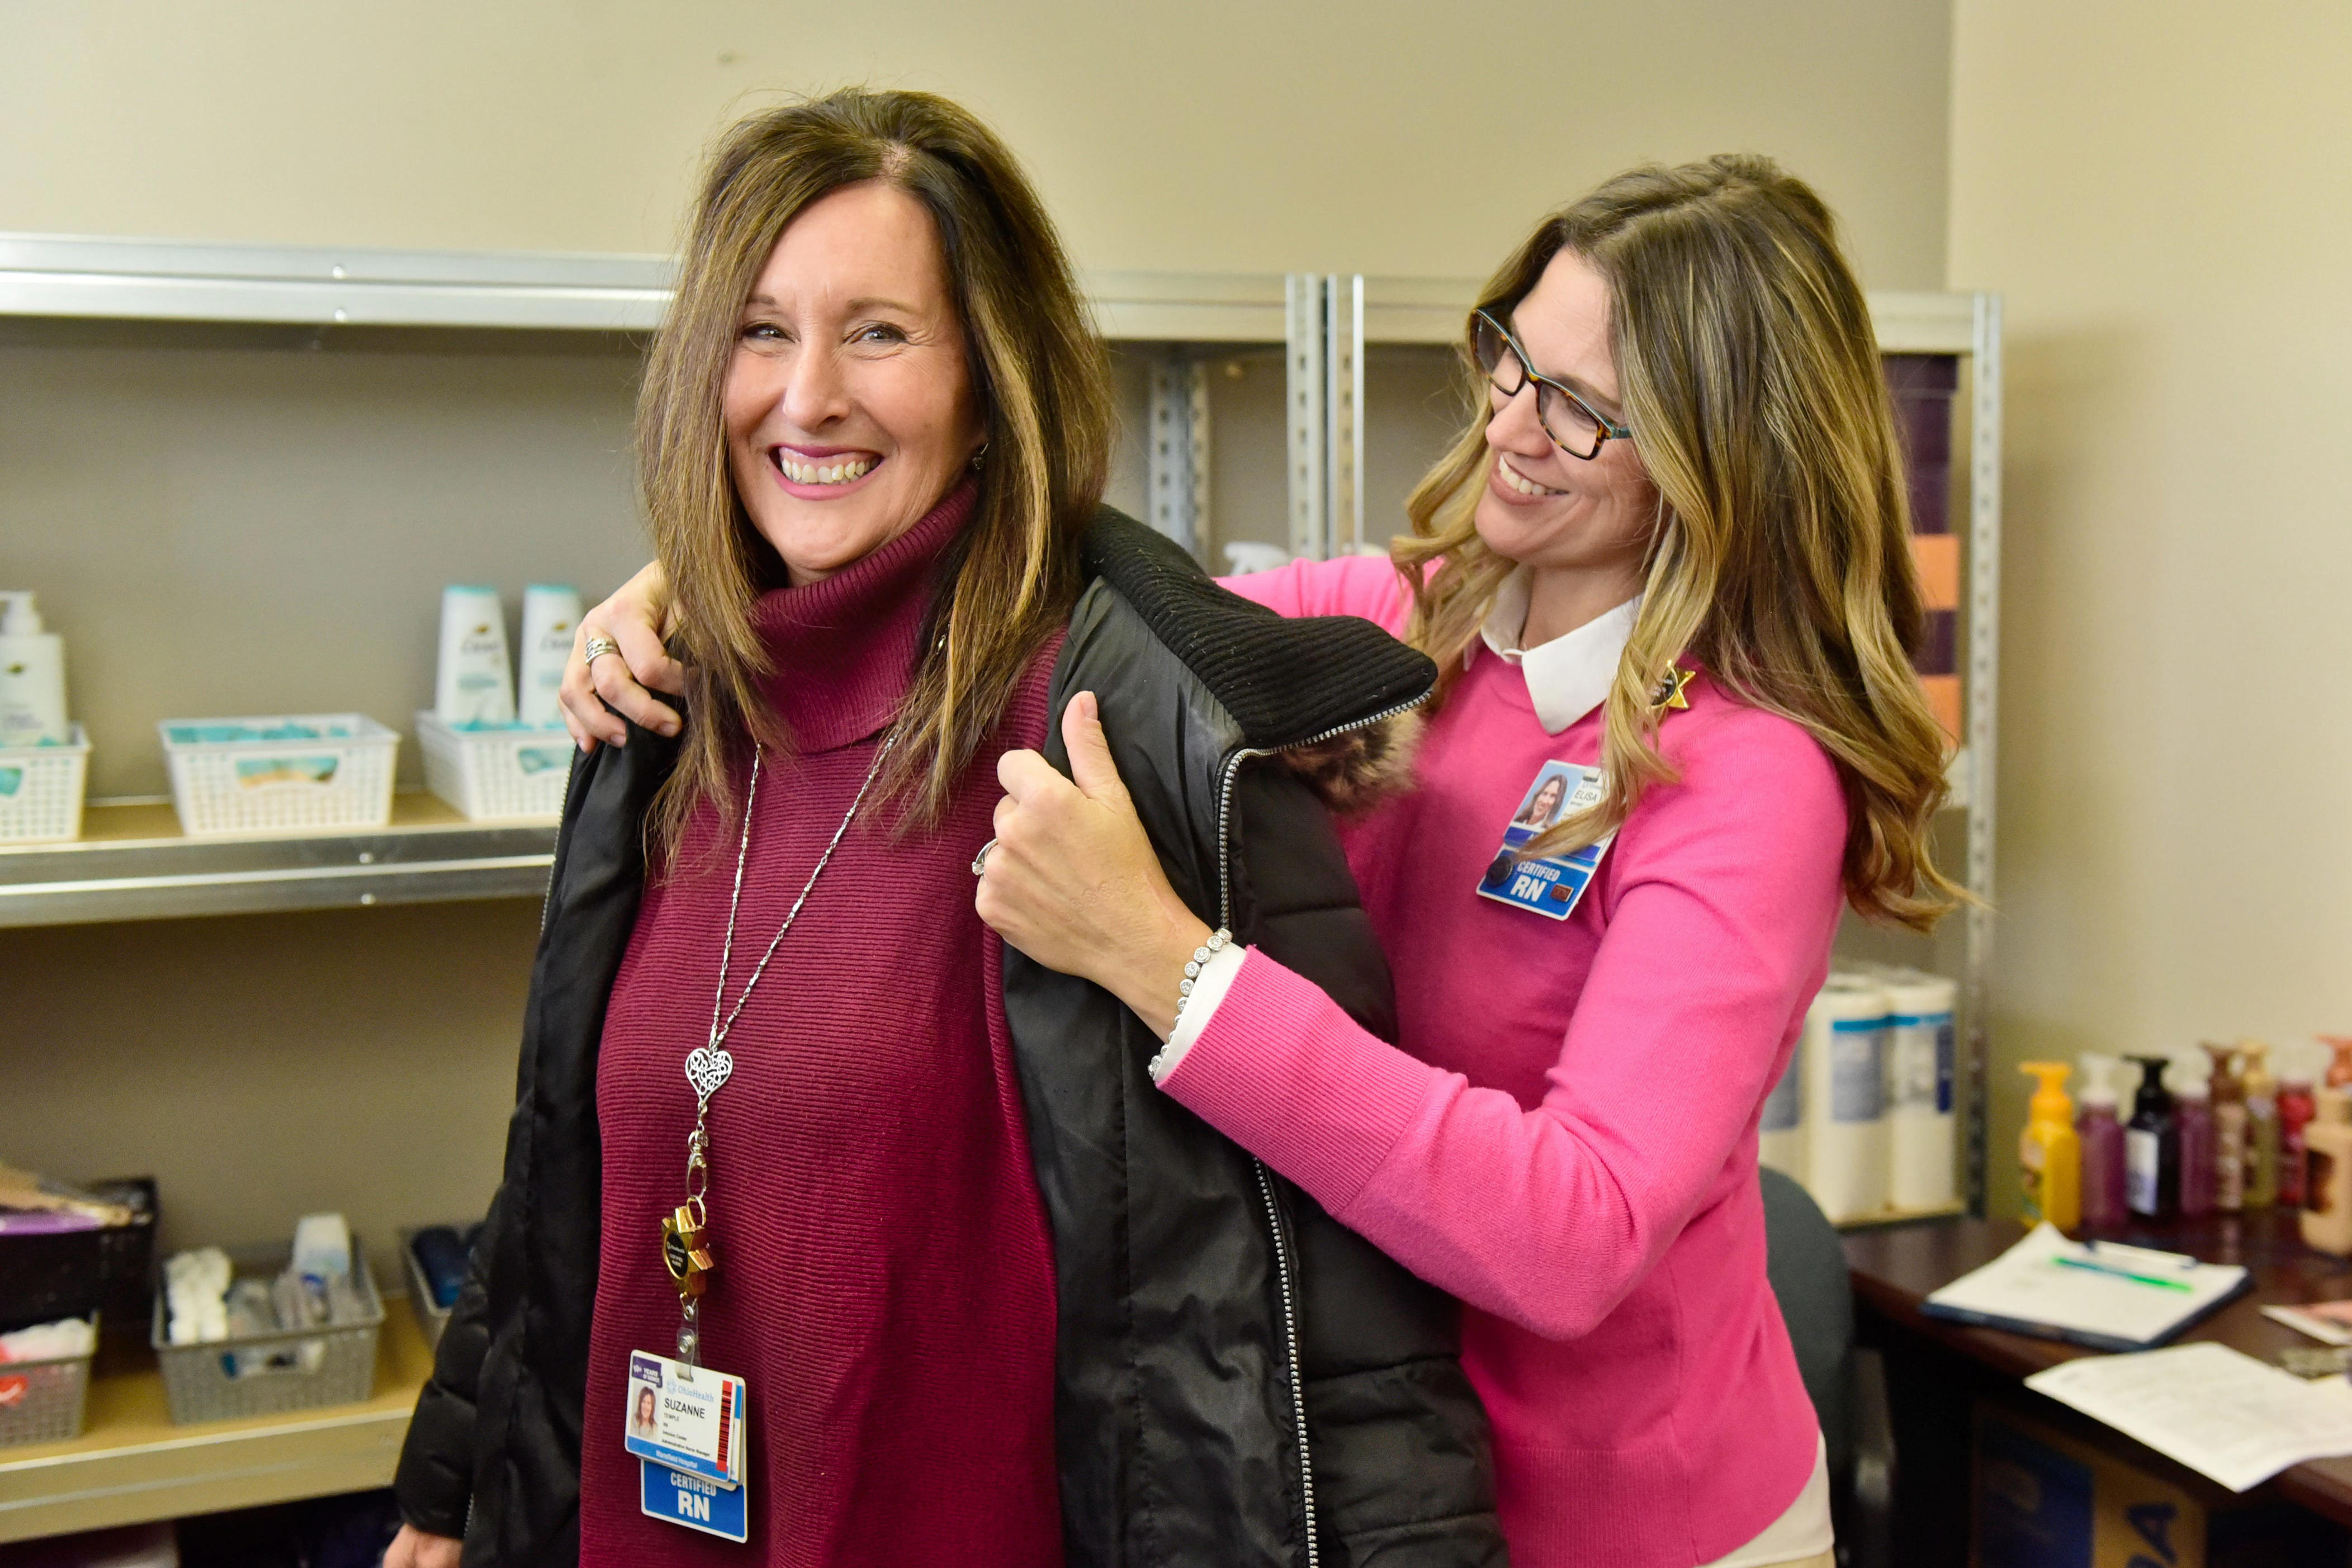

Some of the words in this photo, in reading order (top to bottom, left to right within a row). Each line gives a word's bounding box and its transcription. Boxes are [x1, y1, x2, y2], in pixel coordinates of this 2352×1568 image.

[1574, 789, 1597, 803] ELISA
[1517, 861, 1561, 882] CERTIFIED
[1510, 874, 1547, 902] RN
[643, 1367, 659, 1378] YEARS
[678, 1385, 714, 1403] OhioHealth
[664, 1398, 705, 1419] SUZANNE
[664, 1412, 679, 1422] TEMPLE
[678, 1457, 698, 1468] Hospital
[671, 1472, 717, 1496] CERTIFIED
[678, 1489, 710, 1522] RN
